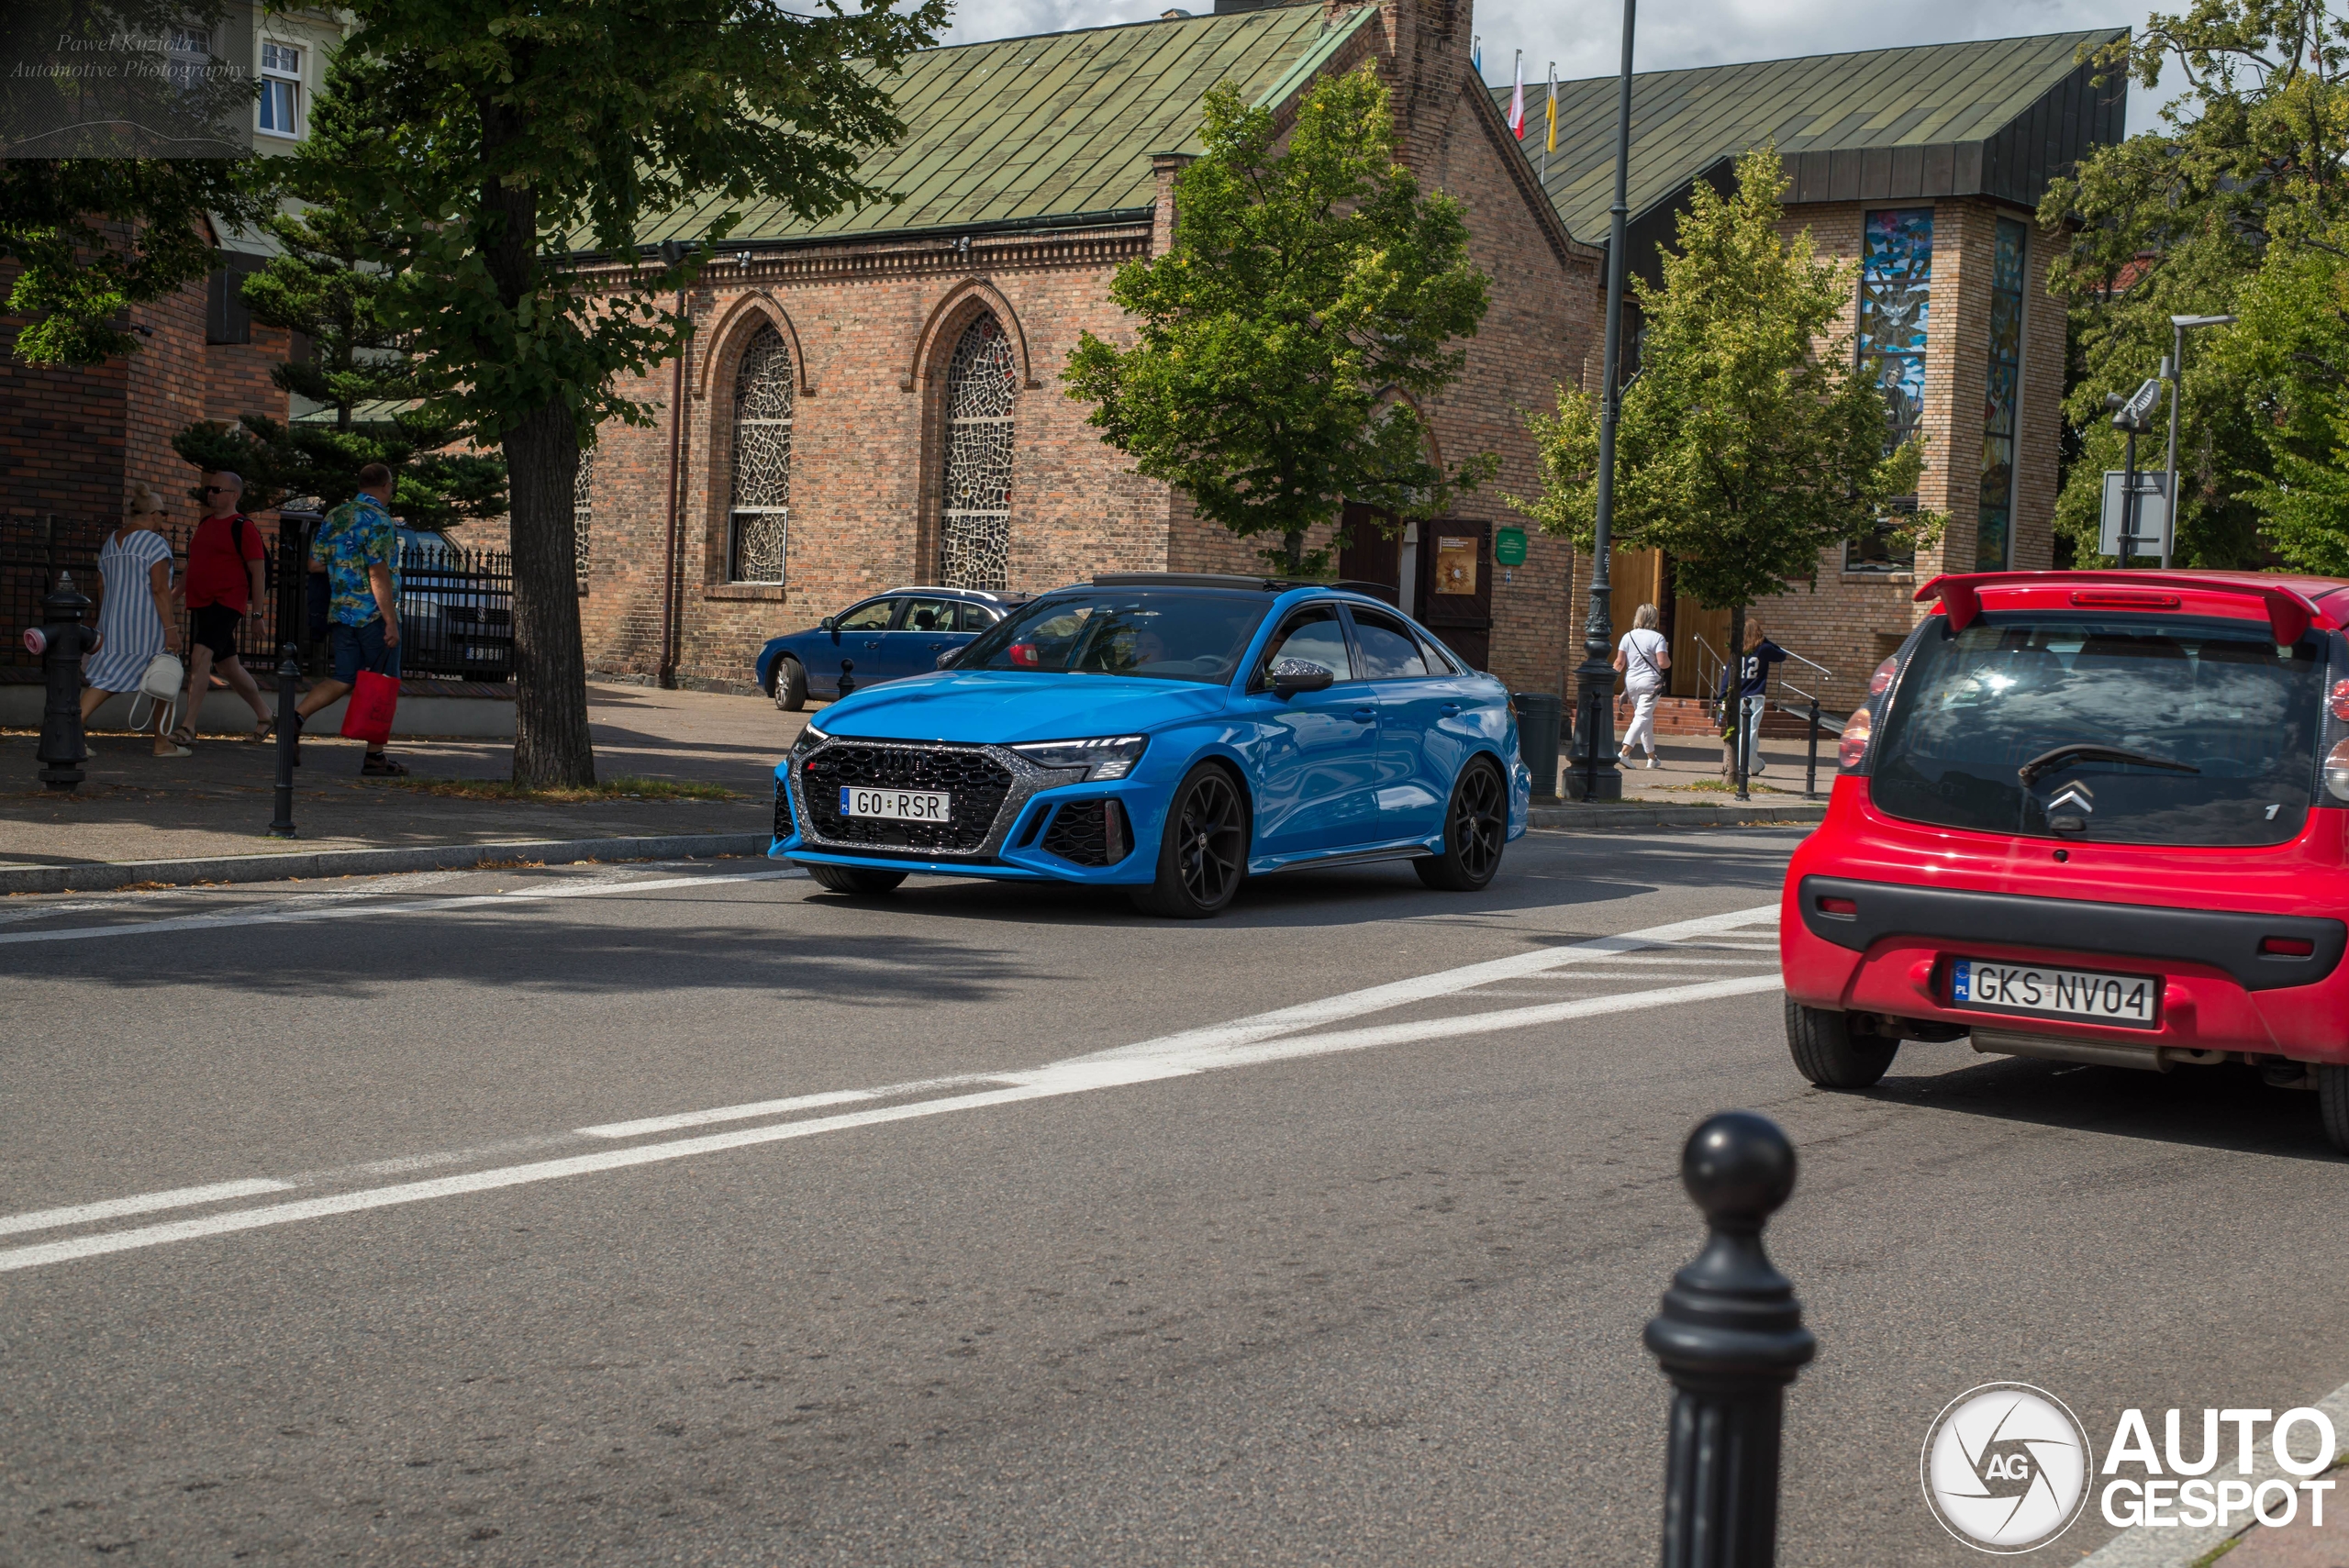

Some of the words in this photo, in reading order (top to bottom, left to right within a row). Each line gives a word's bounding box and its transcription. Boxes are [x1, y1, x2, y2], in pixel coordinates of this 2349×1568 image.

[898, 795, 940, 818] RSR
[1955, 984, 1968, 995] PL
[1976, 966, 2043, 1006] GKS
[2055, 973, 2145, 1018] NV04
